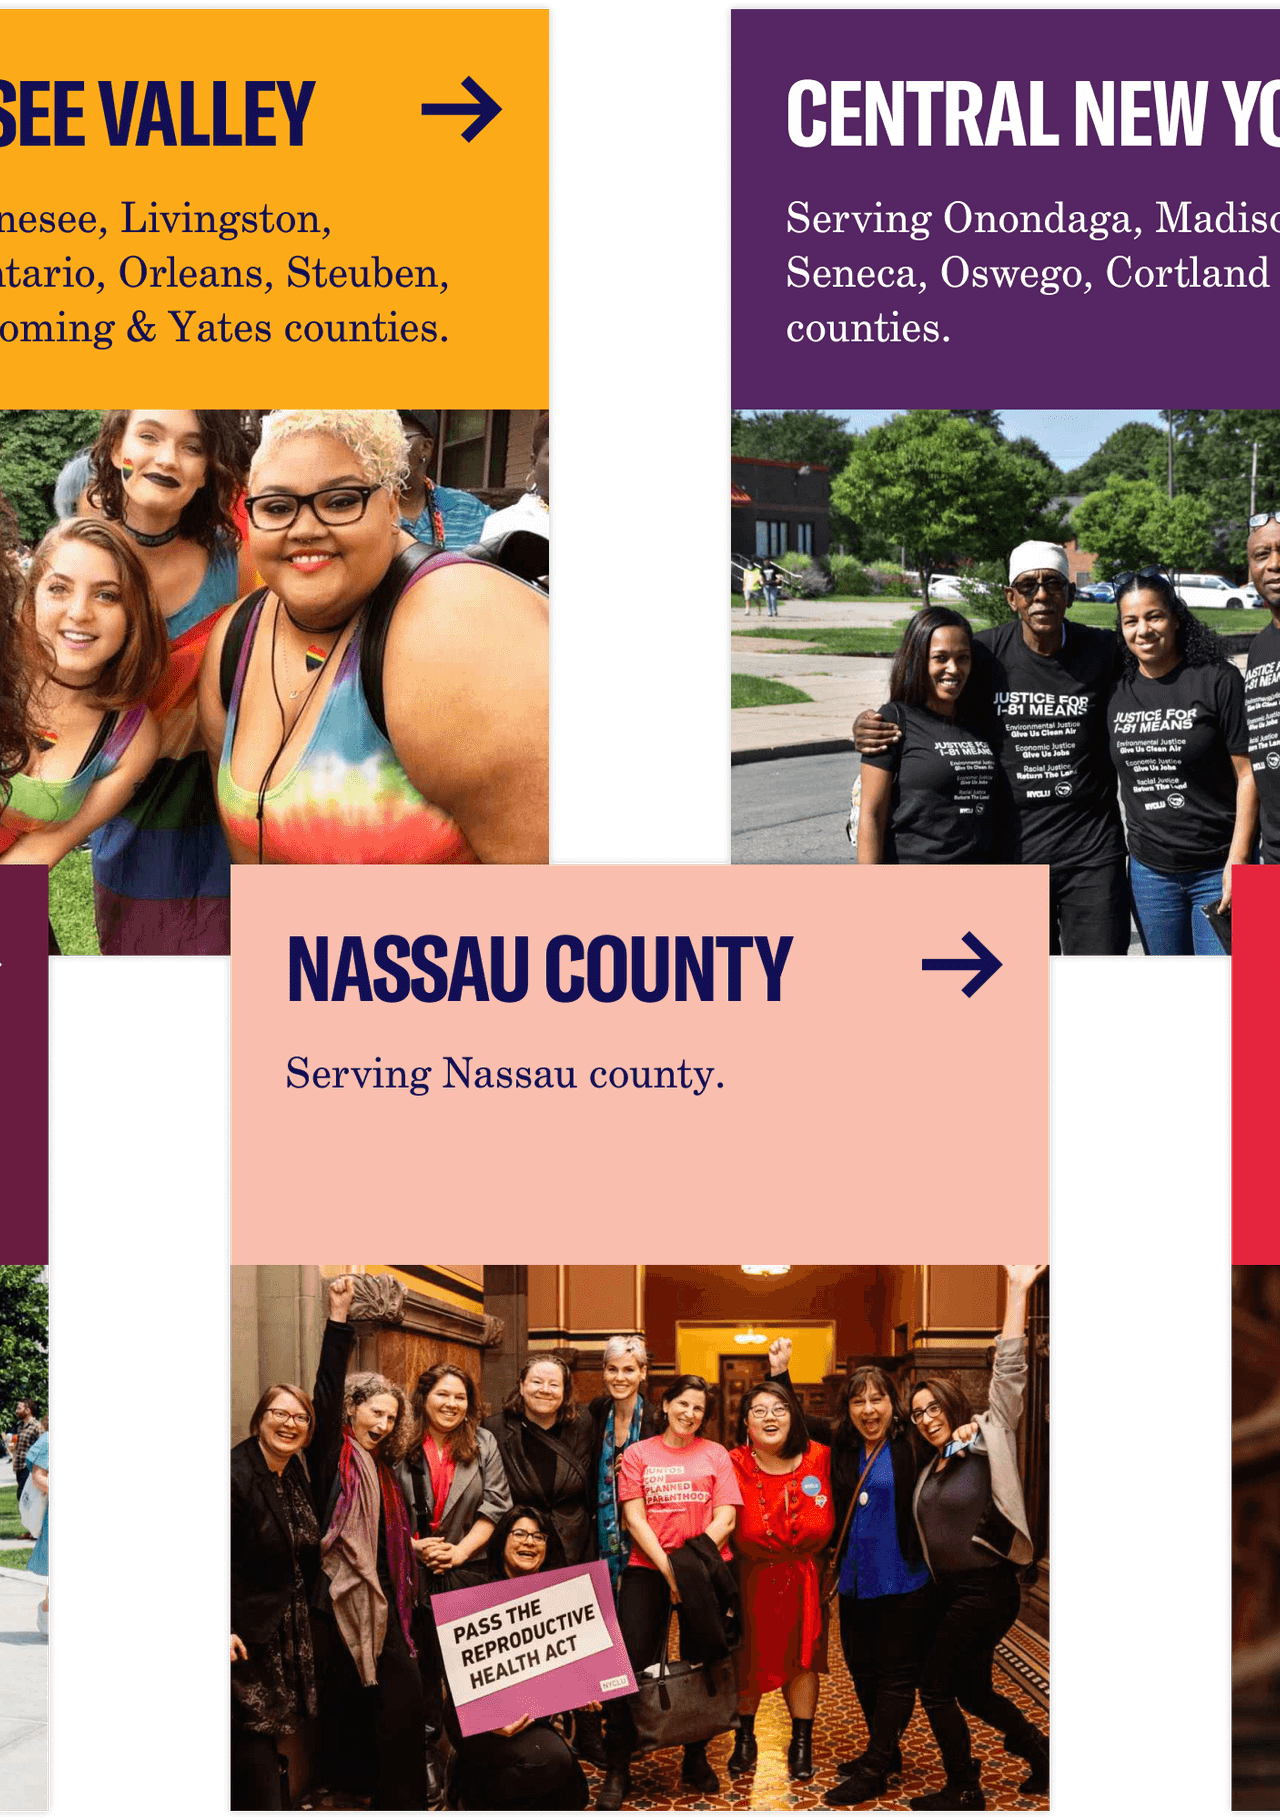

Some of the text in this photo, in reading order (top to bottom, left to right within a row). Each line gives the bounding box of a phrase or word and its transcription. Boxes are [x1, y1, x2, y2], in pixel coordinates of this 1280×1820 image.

[993, 692, 1089, 708] JUSTICE FOR
[997, 704, 1087, 716] I-81 MEANS
[1113, 708, 1197, 723] JUSTICE FOR
[1005, 722, 1055, 731] Environmental
[1114, 719, 1193, 734] I-81 MEANS
[645, 1483, 690, 1494] PLANNED
[646, 1493, 707, 1504] PARENTHOO
[453, 1599, 542, 1644] PASS THE
[461, 1603, 595, 1667] REPRODUCTIVE
[470, 1635, 577, 1690] HEALTH ACT
[602, 1677, 627, 1690] NYCLU
